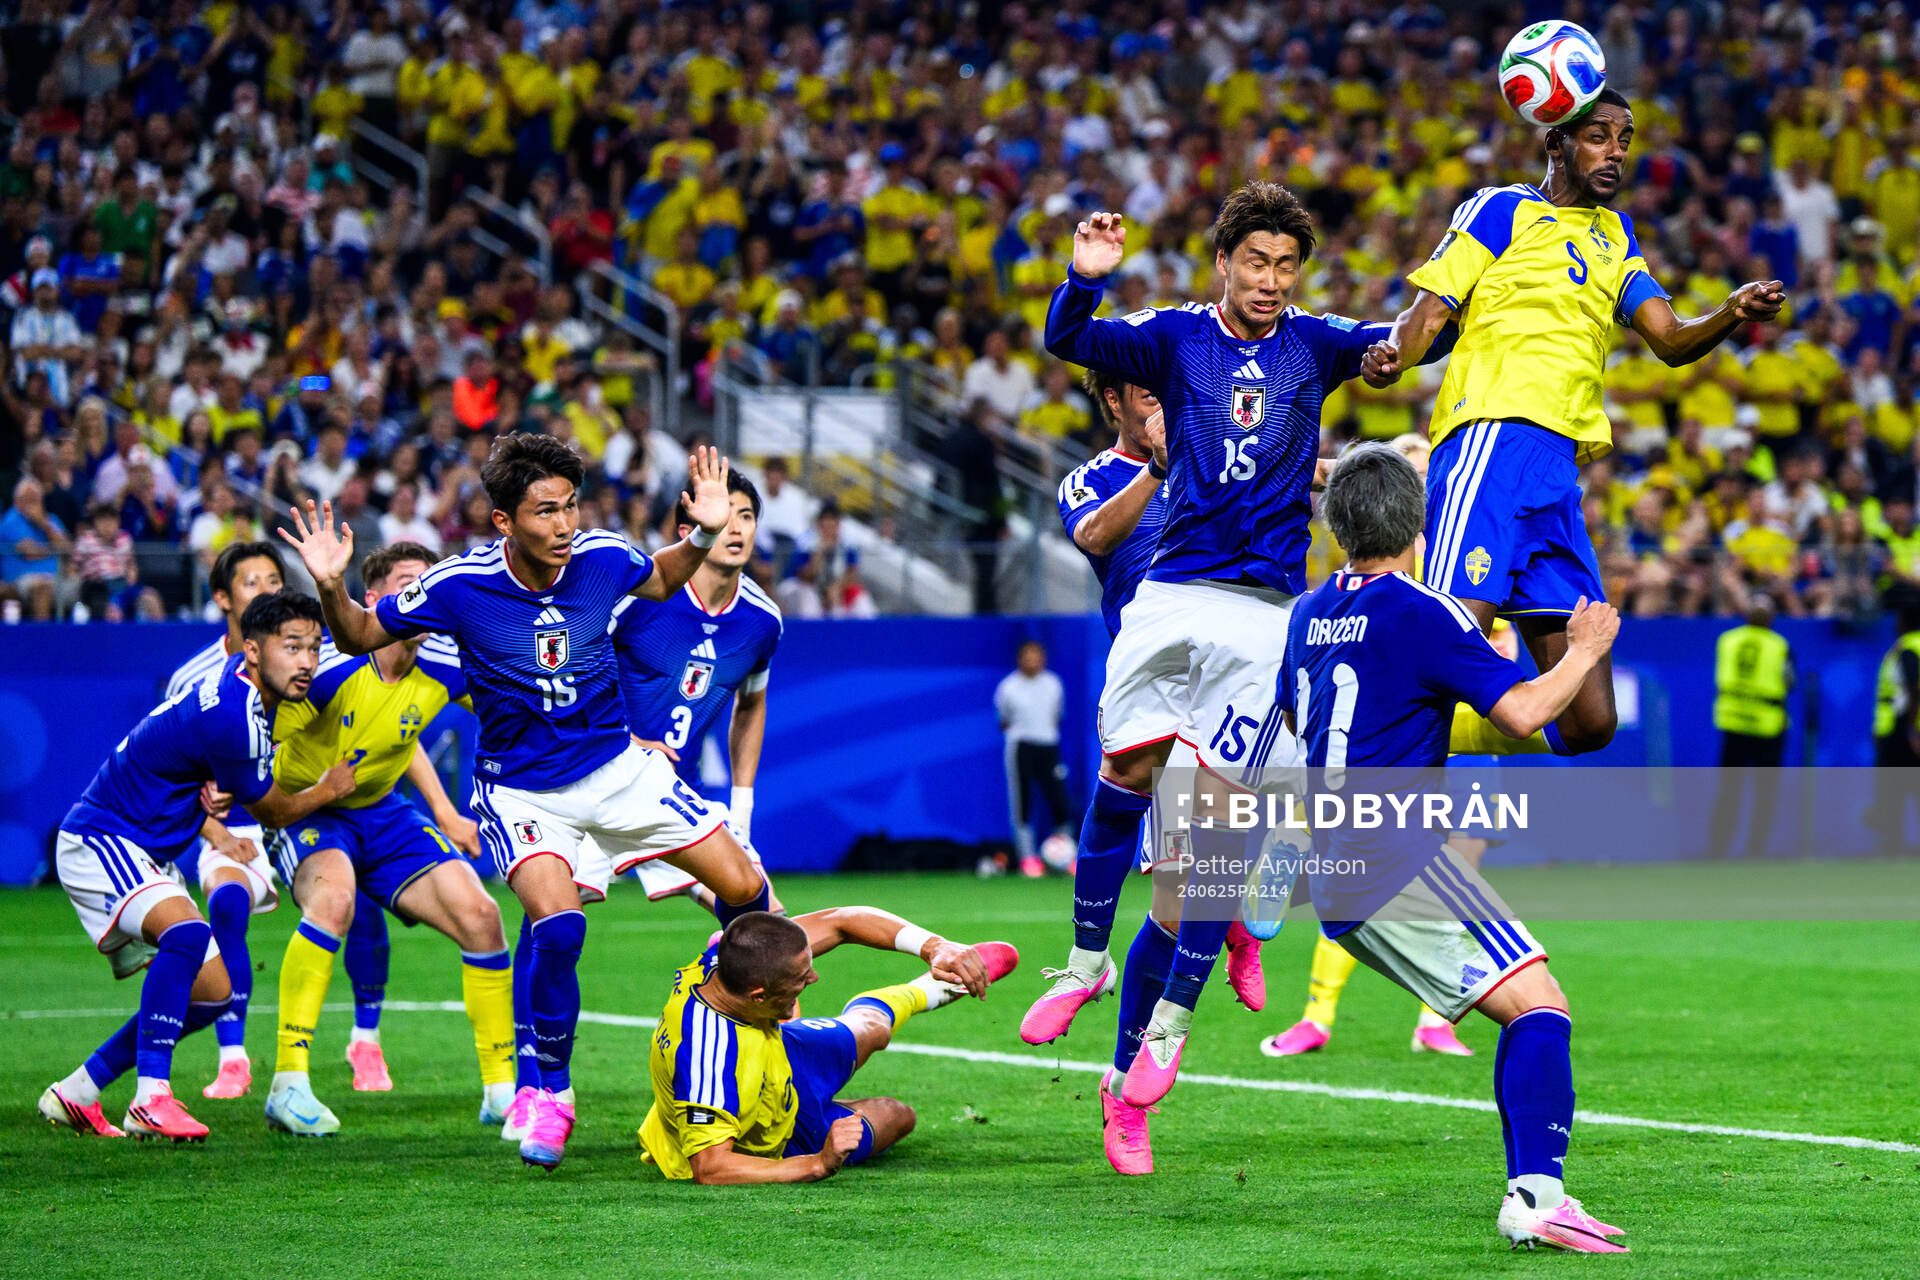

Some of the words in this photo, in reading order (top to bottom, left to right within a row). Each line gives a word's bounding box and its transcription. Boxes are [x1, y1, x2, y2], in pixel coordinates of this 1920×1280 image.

[1566, 241, 1588, 285] 9
[1219, 435, 1259, 484] 15
[535, 672, 577, 712] 16
[665, 705, 692, 749] 3
[1209, 704, 1260, 763] 15
